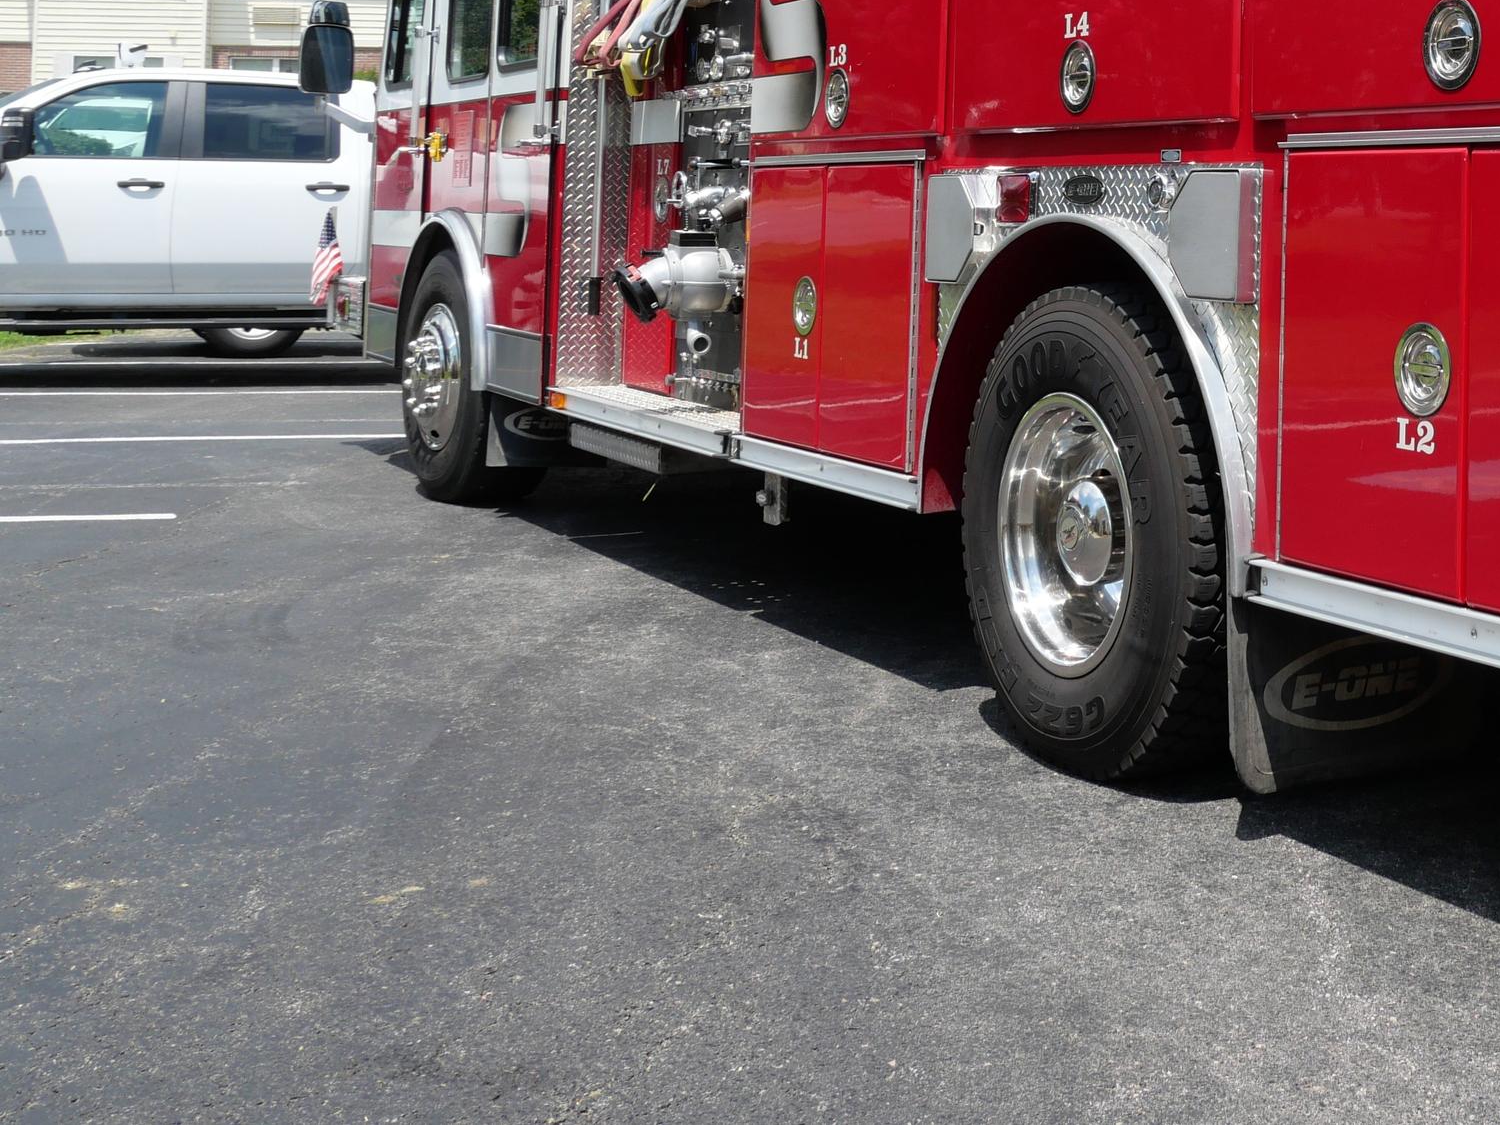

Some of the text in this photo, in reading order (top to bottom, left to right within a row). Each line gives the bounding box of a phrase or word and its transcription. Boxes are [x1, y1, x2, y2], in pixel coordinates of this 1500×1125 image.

[1064, 11, 1090, 39] L4
[828, 43, 847, 67] L3
[656, 158, 670, 175] L7
[0, 229, 16, 237] 0
[793, 336, 810, 360] L1
[996, 339, 1154, 526] GOODYEAR
[1395, 416, 1436, 455] L2
[1290, 656, 1422, 711] E-ONE
[1025, 691, 1106, 736] G622
